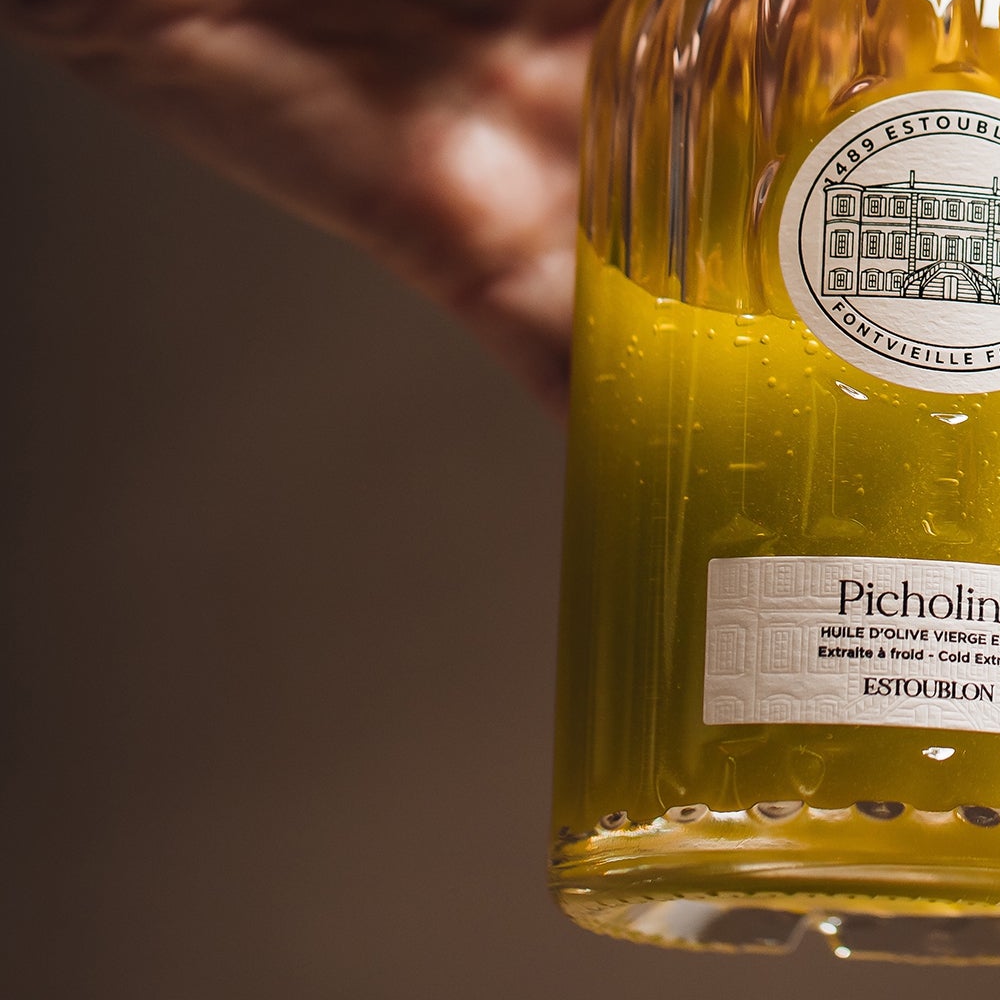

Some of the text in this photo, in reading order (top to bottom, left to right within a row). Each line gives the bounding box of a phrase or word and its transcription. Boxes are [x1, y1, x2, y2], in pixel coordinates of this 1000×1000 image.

[832, 300, 974, 365] FONTVIEILLE
[820, 626, 865, 638] HUILE
[869, 627, 929, 642] D'OLIVE
[933, 630, 987, 645] VIERGE
[818, 646, 874, 660] Extraite
[877, 646, 886, 660] à
[890, 647, 924, 661] froid
[938, 649, 971, 664] Cold
[863, 677, 994, 703] ESTOUBLON
